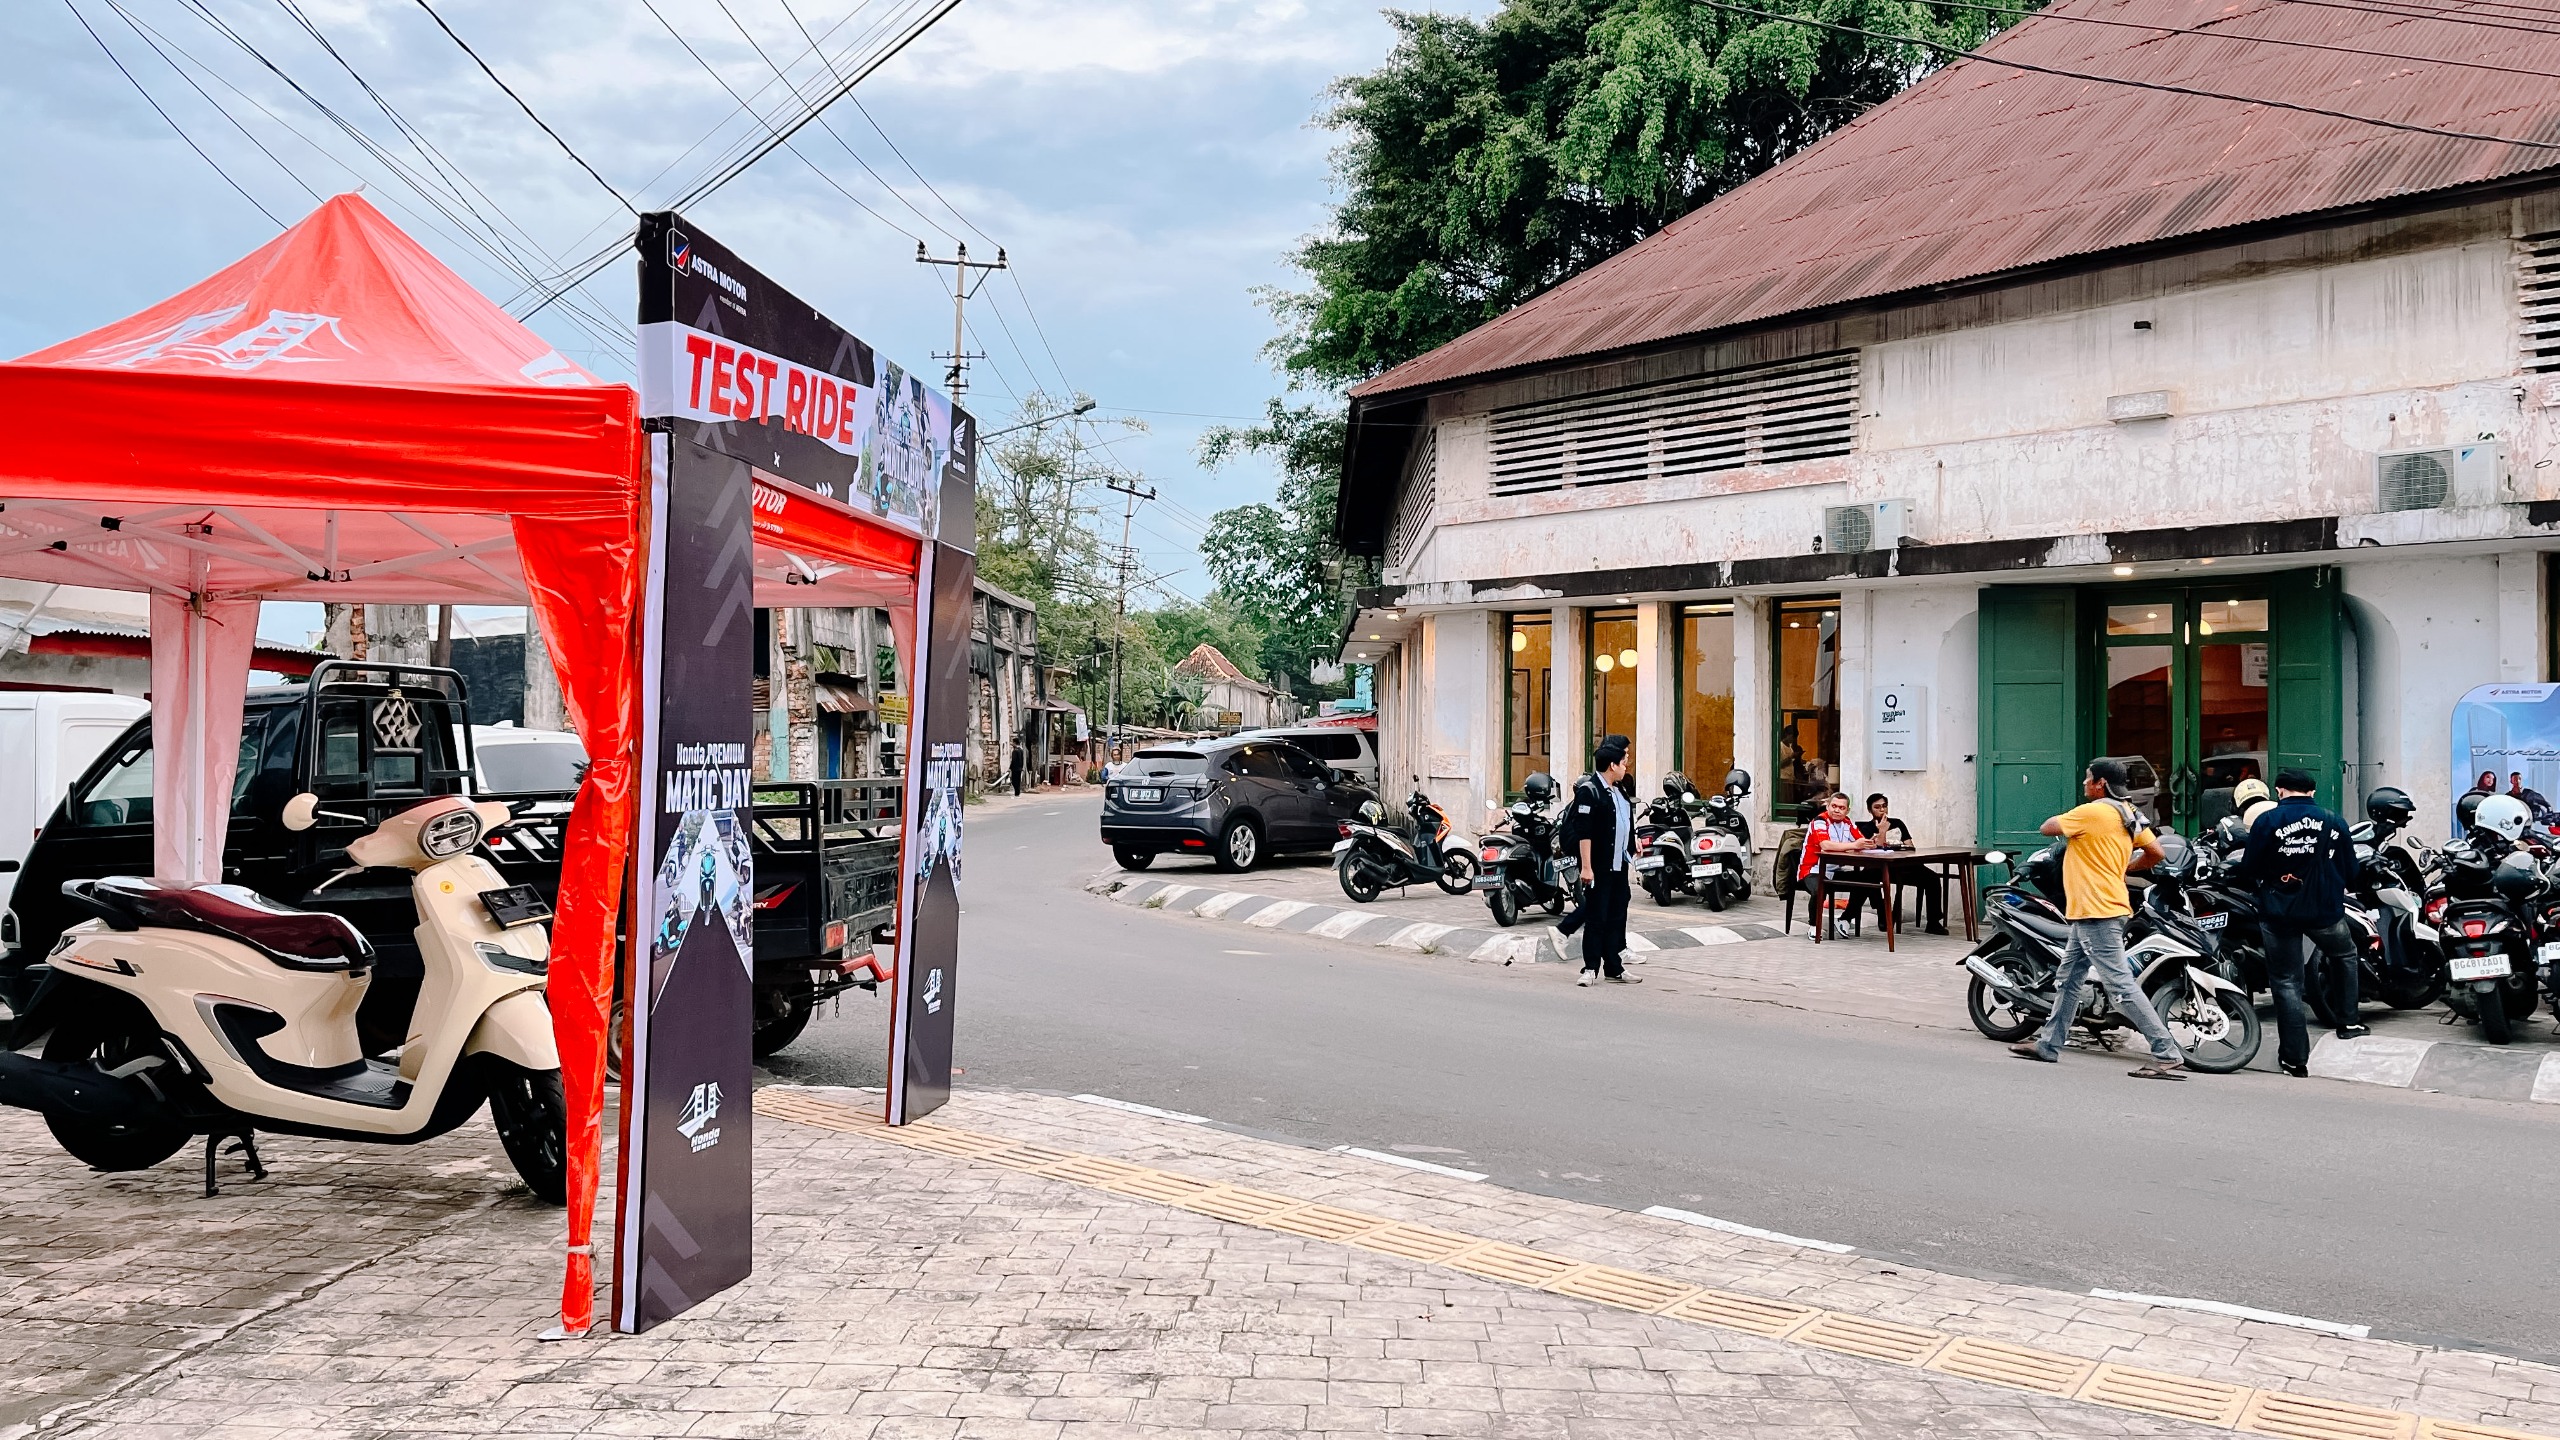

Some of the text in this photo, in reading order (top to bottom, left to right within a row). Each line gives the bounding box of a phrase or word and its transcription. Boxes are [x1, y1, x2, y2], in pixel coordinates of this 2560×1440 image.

[691, 254, 747, 302] ASTRA MOTOR
[685, 333, 779, 426] TEST
[783, 366, 857, 446] RIDE
[752, 482, 788, 515] OTOR
[676, 741, 746, 766] Honda PREMIUM
[665, 768, 752, 814] MATIC DAY
[925, 760, 966, 790] MATIC DAY
[690, 1127, 721, 1148] Honda
